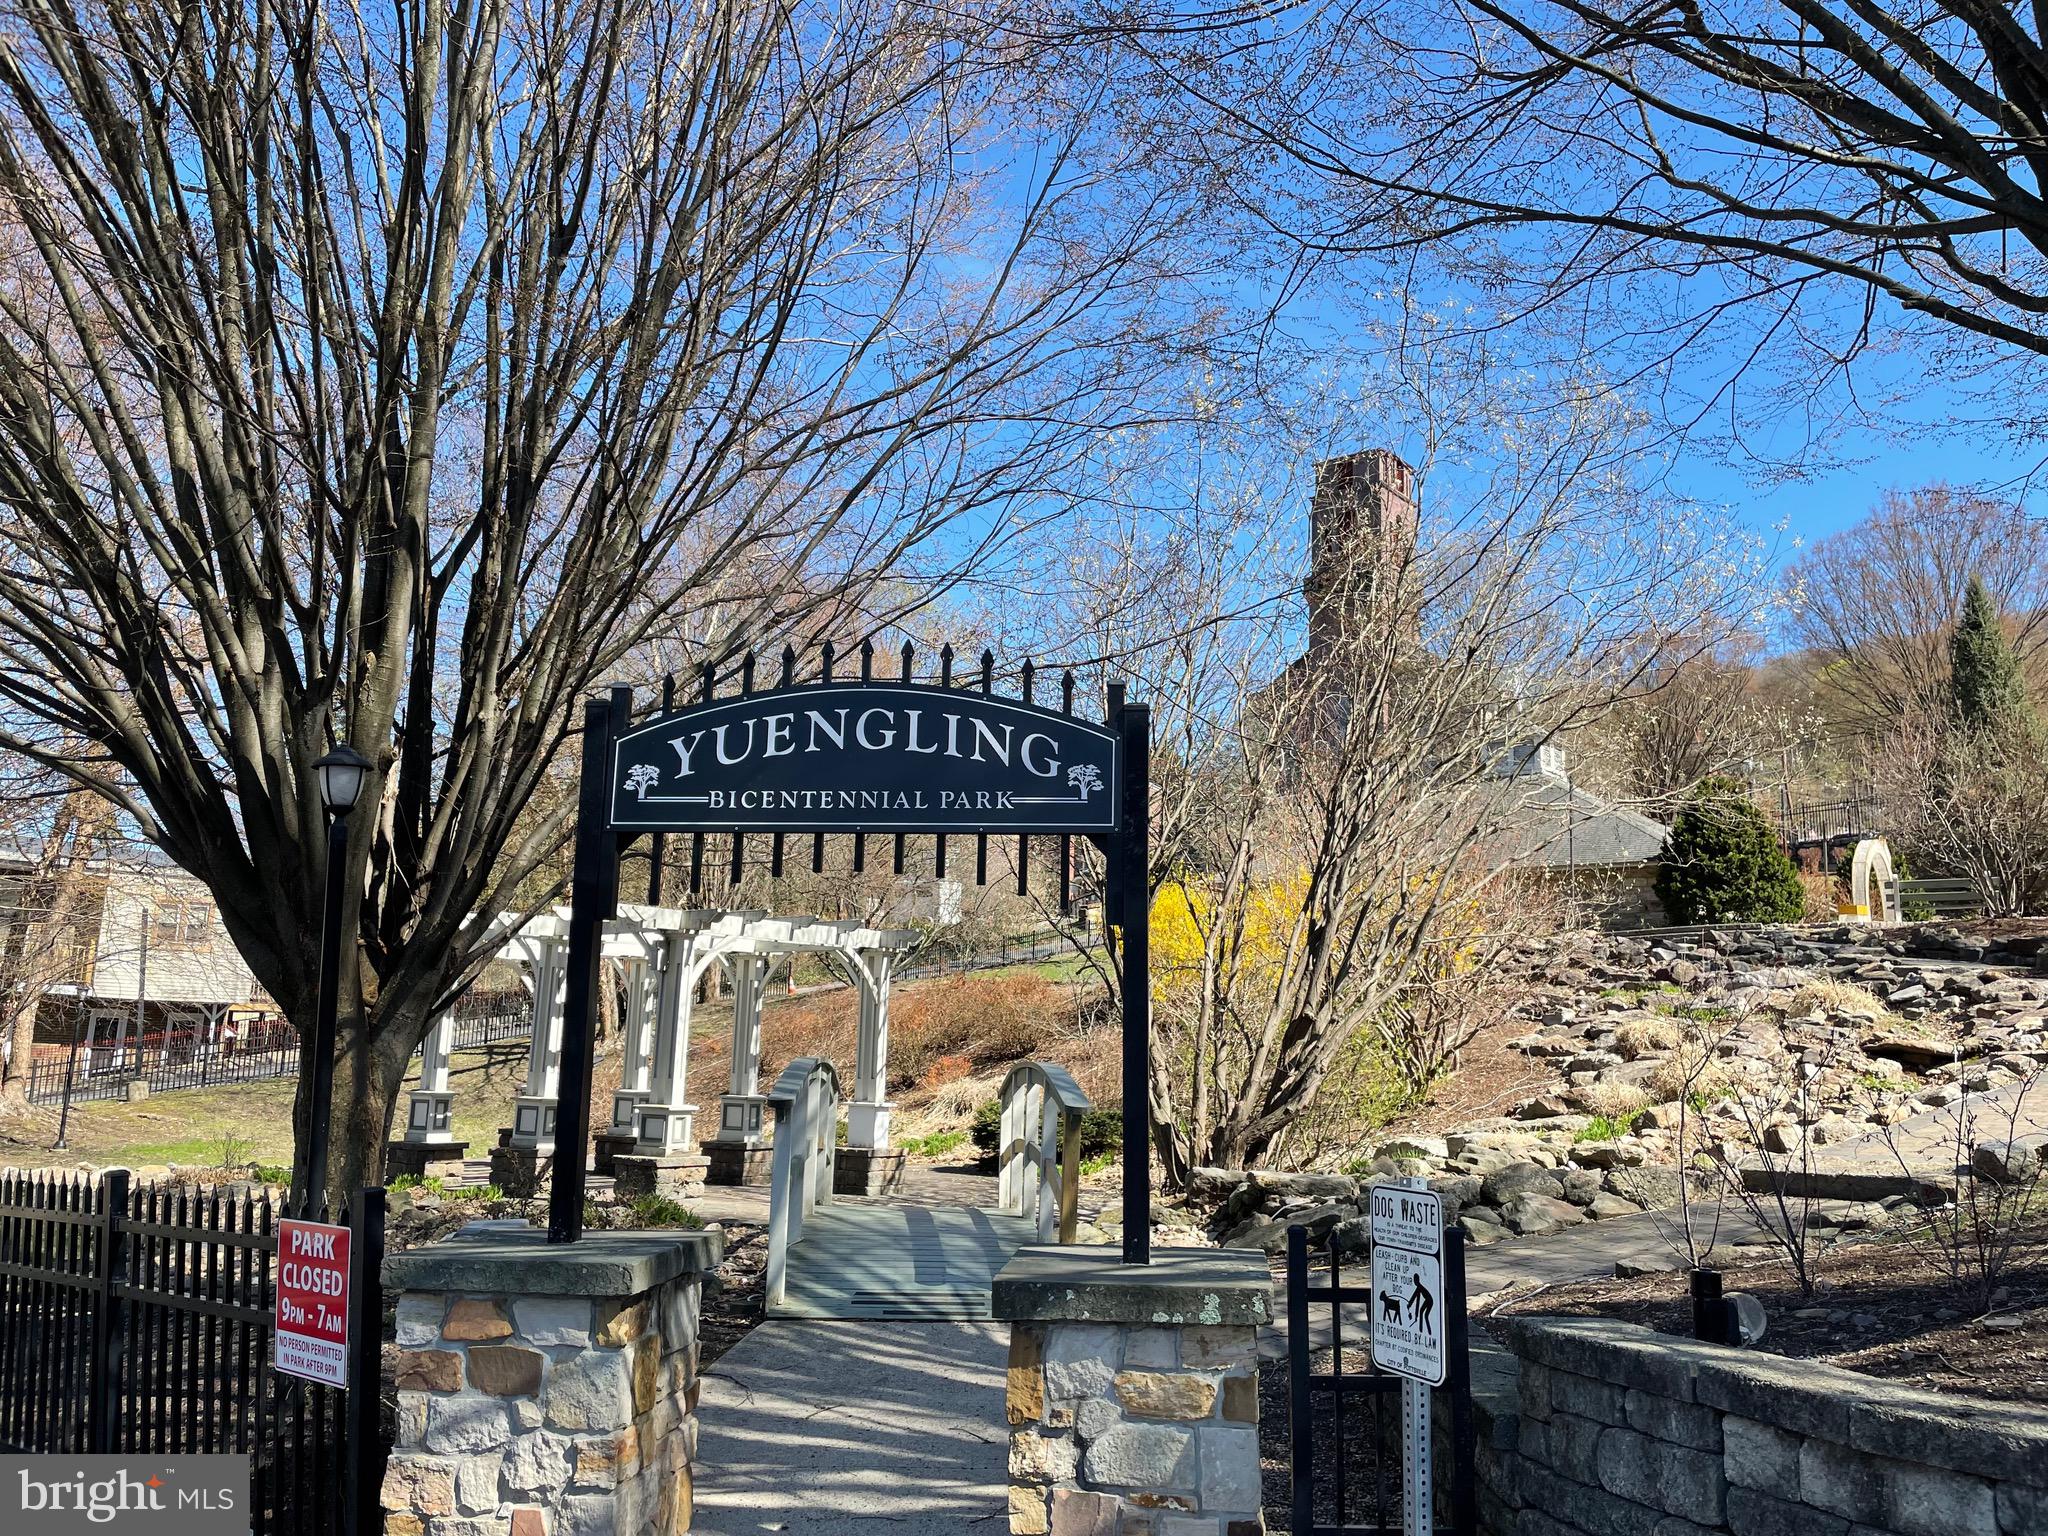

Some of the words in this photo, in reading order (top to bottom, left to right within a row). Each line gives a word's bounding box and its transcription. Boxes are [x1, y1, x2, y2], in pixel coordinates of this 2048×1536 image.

[667, 708, 1062, 780] YUENGLING
[708, 790, 928, 810] BICENTENNIAL
[940, 790, 1014, 810] PARK
[1374, 1196, 1394, 1219] DOG
[1402, 1198, 1436, 1227] WASTE
[291, 1229, 336, 1261] PARK
[1384, 1262, 1401, 1272] CLEAN
[1402, 1266, 1410, 1274] UP
[1410, 1256, 1420, 1267] AND
[282, 1262, 343, 1297] CLOSED
[1384, 1272, 1398, 1283] AFTER
[1400, 1276, 1413, 1286] YOUR
[1392, 1284, 1403, 1295] DOG
[281, 1297, 305, 1325] 9PM
[316, 1304, 342, 1333] 7AM
[280, 1336, 288, 1348] NO
[288, 1338, 310, 1353] PERSON
[312, 1342, 343, 1361] PERMITTED
[1386, 1326, 1412, 1343] REQUIRED
[1424, 1336, 1437, 1350] LAW
[284, 1352, 290, 1364] IN
[290, 1354, 305, 1369] PARK
[306, 1358, 324, 1373] AFTER
[324, 1364, 338, 1377] 9PM
